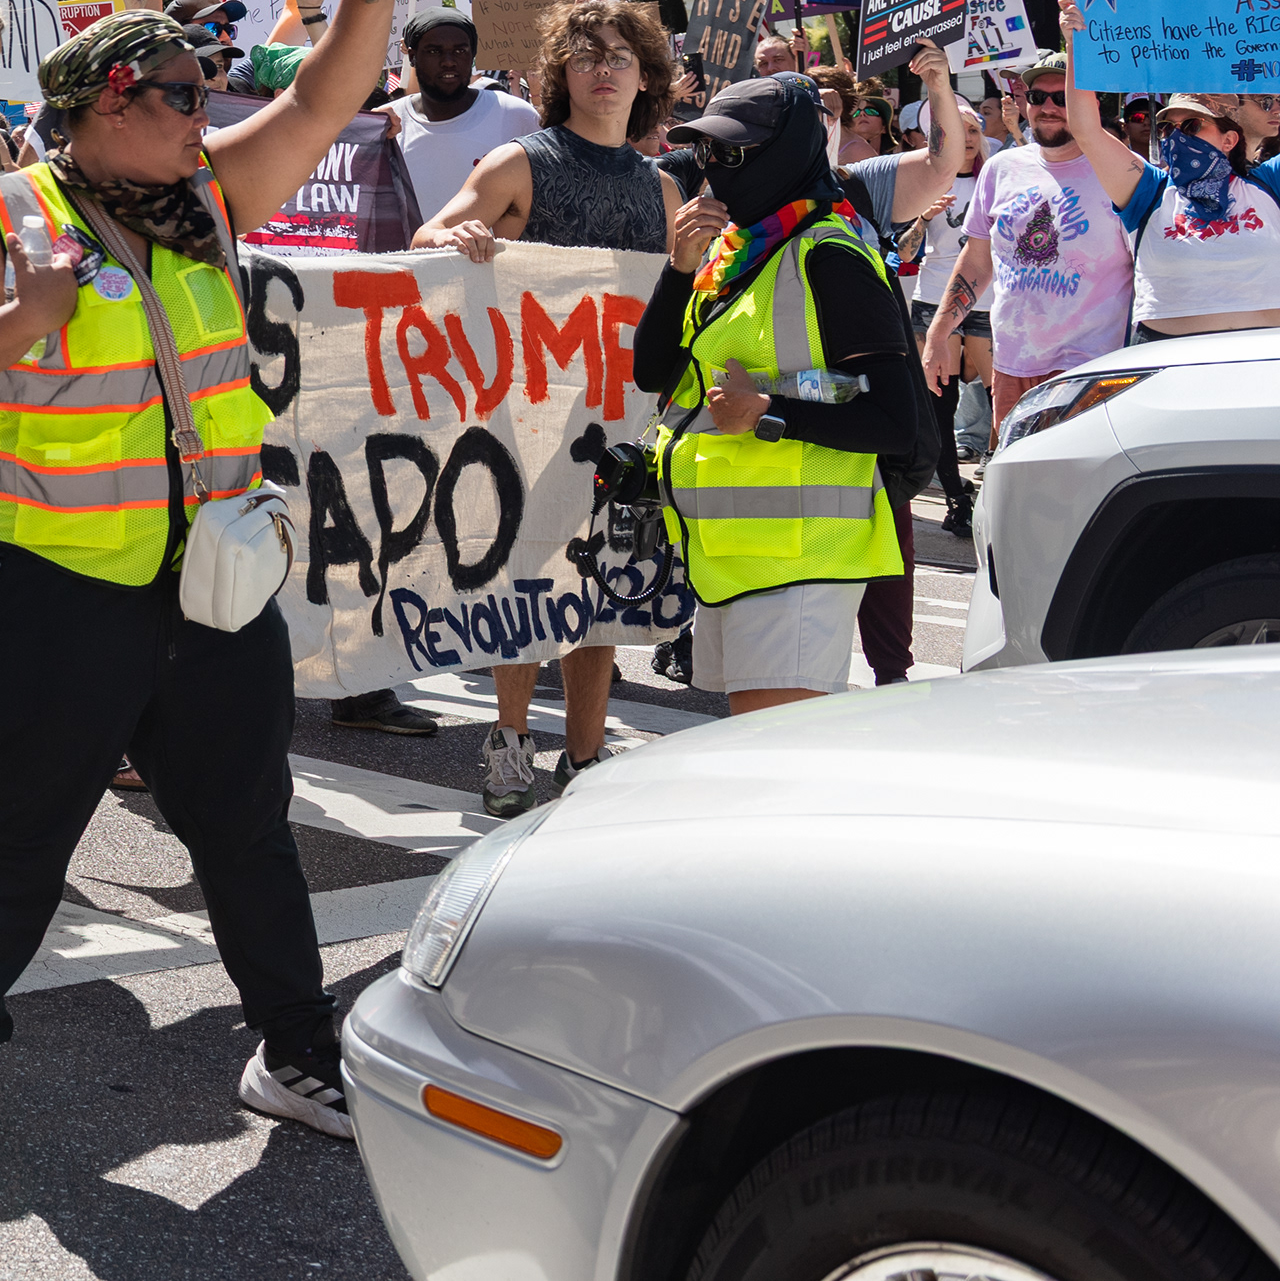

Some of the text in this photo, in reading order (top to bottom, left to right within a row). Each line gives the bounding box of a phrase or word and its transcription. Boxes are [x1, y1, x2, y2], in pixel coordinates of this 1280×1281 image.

[867, 46, 883, 65] just
[885, 38, 902, 54] feel
[904, 12, 963, 47] embarrassed
[968, 28, 1013, 57] ALL
[1089, 20, 1151, 41] Citizens
[1162, 17, 1202, 40] have
[1204, 16, 1237, 36] the
[698, 26, 742, 69] AND
[1098, 44, 1120, 64] to
[1131, 40, 1189, 67] petition
[1202, 42, 1226, 59] the
[297, 183, 360, 213] LAW
[1052, 187, 1089, 241] YOUR
